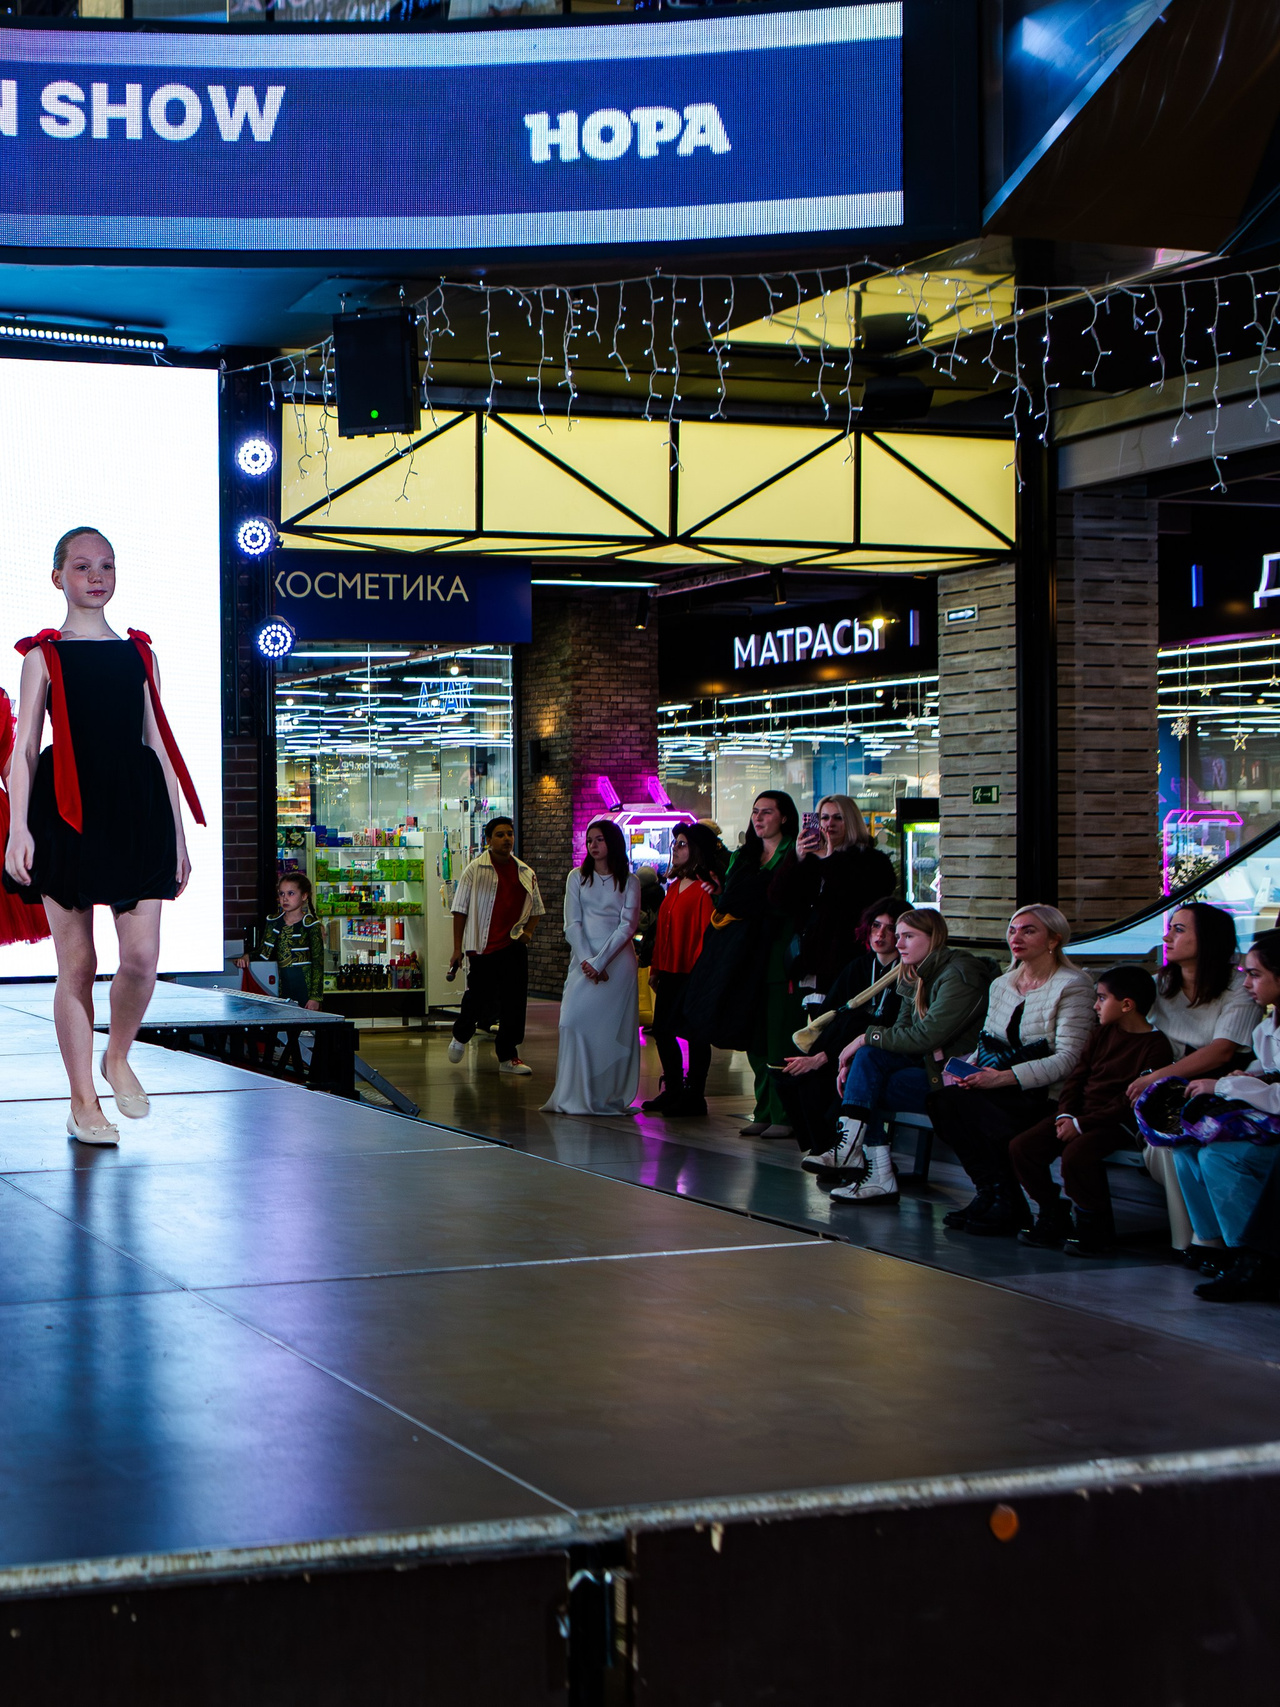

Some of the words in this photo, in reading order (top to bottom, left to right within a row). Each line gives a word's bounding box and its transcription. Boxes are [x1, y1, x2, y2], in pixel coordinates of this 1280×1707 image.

[40, 81, 286, 142] SHOW
[274, 570, 469, 602] КОСМЕТИКА
[734, 618, 880, 670] МАТРАСЫ
